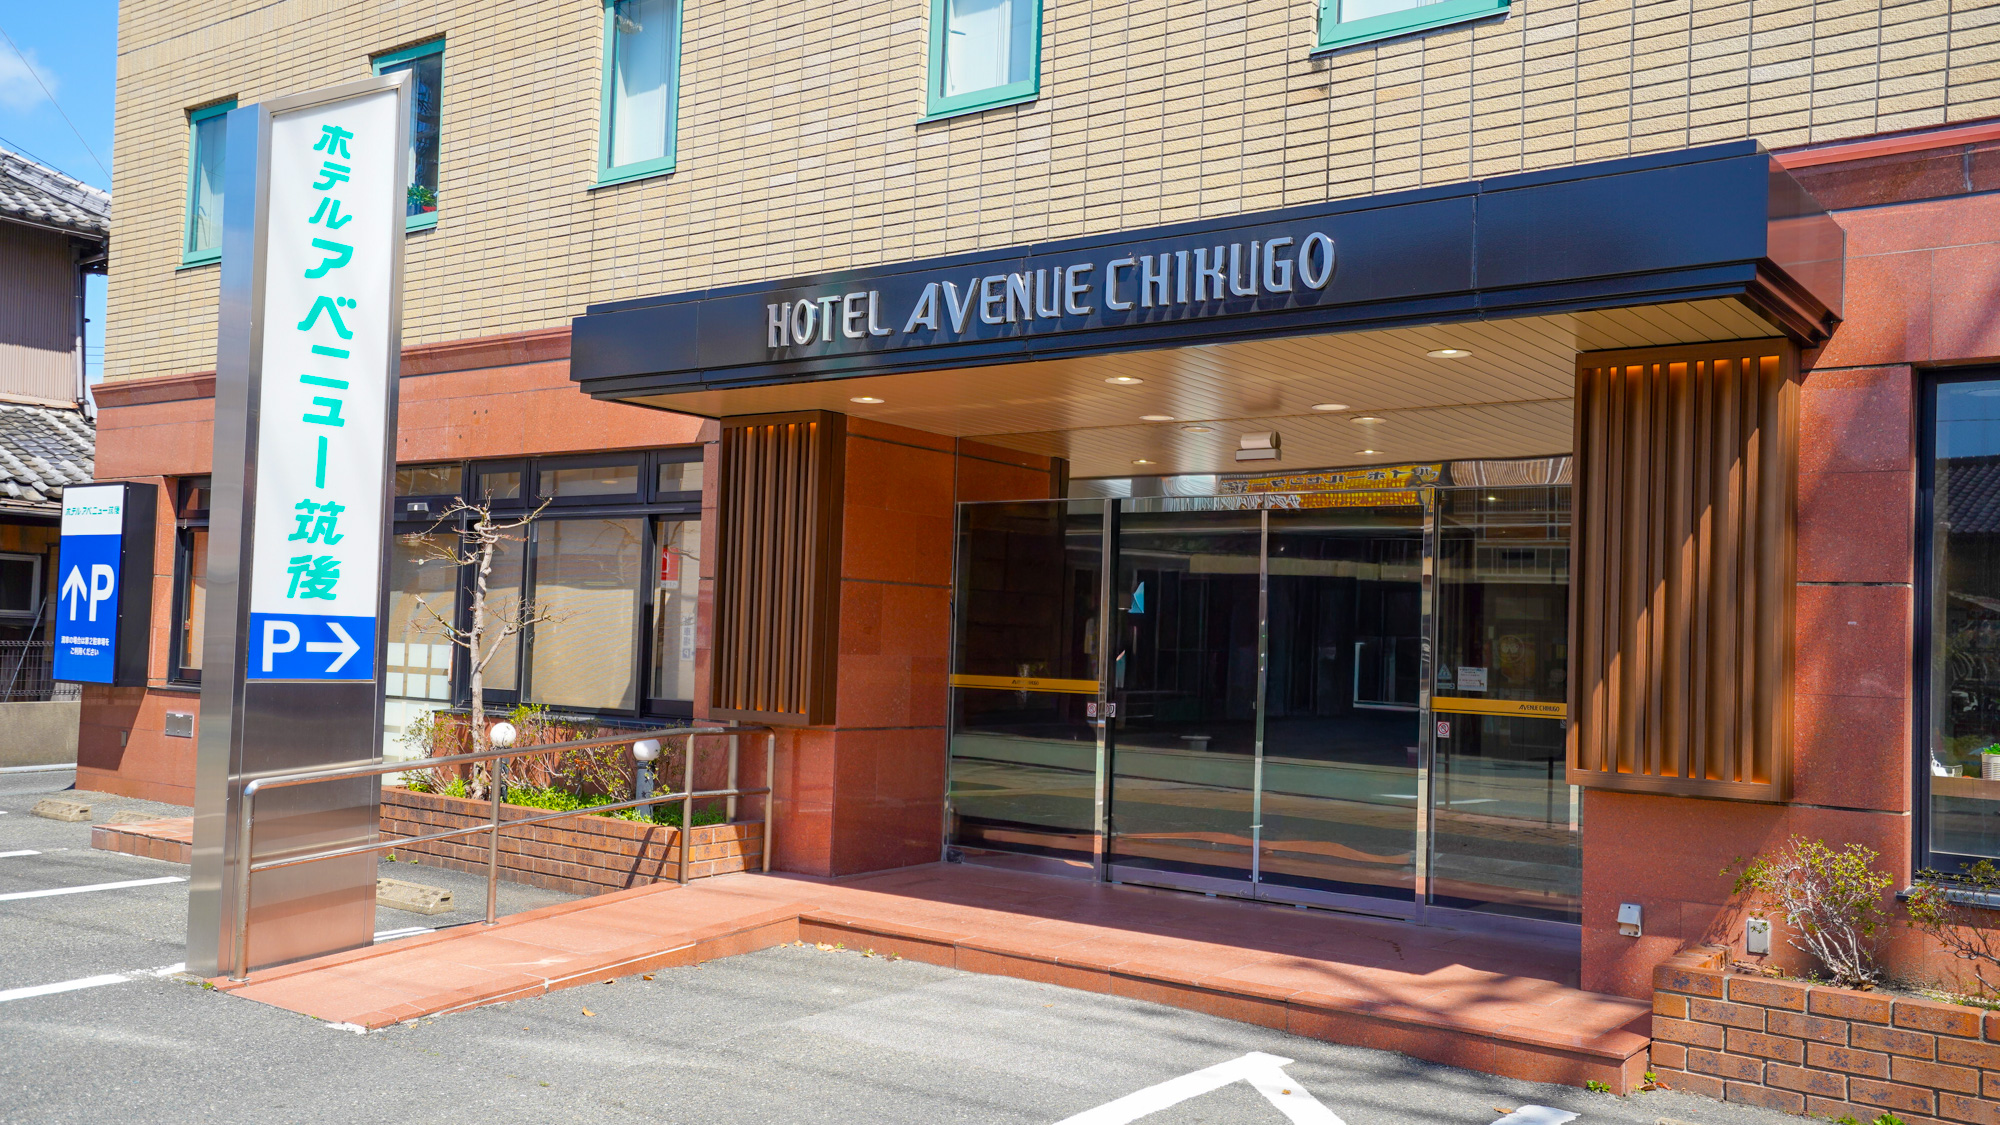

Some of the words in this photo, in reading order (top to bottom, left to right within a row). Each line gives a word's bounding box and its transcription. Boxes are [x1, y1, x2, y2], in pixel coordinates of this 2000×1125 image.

[766, 290, 893, 348] HOTEL
[903, 263, 1094, 335] AVENUE
[1105, 232, 1336, 311] CHIKUGO
[287, 124, 357, 601] ホテルアベニュー筑後
[89, 564, 115, 622] P
[262, 620, 300, 672] P
